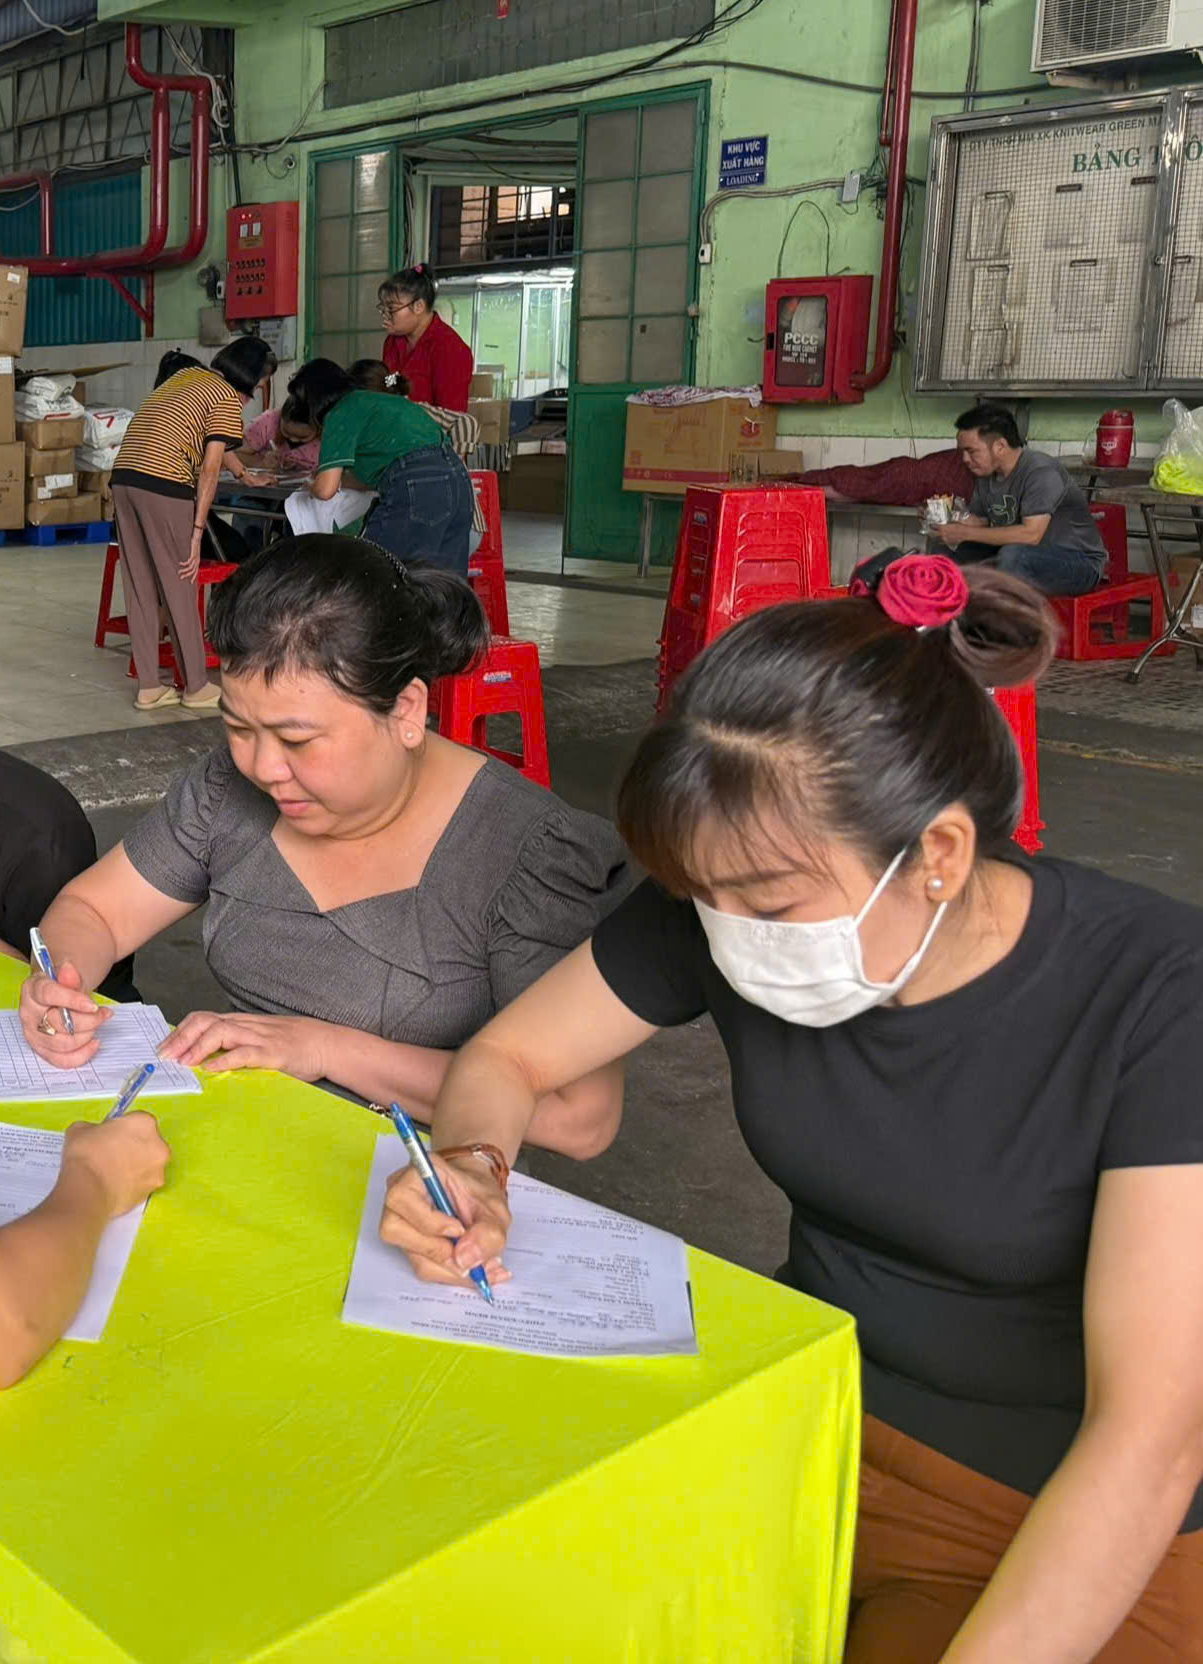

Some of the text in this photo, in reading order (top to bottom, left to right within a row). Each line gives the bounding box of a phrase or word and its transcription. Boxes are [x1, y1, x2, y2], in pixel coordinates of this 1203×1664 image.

[1052, 122, 1107, 139] KNITWEAR
[1108, 118, 1145, 132] GREEN
[727, 140, 760, 154] KHU VỰC
[722, 155, 764, 170] XUẤT HÀNG
[1072, 143, 1141, 173] BẢNG
[726, 175, 757, 186] LOADING
[784, 331, 818, 345] PCCC
